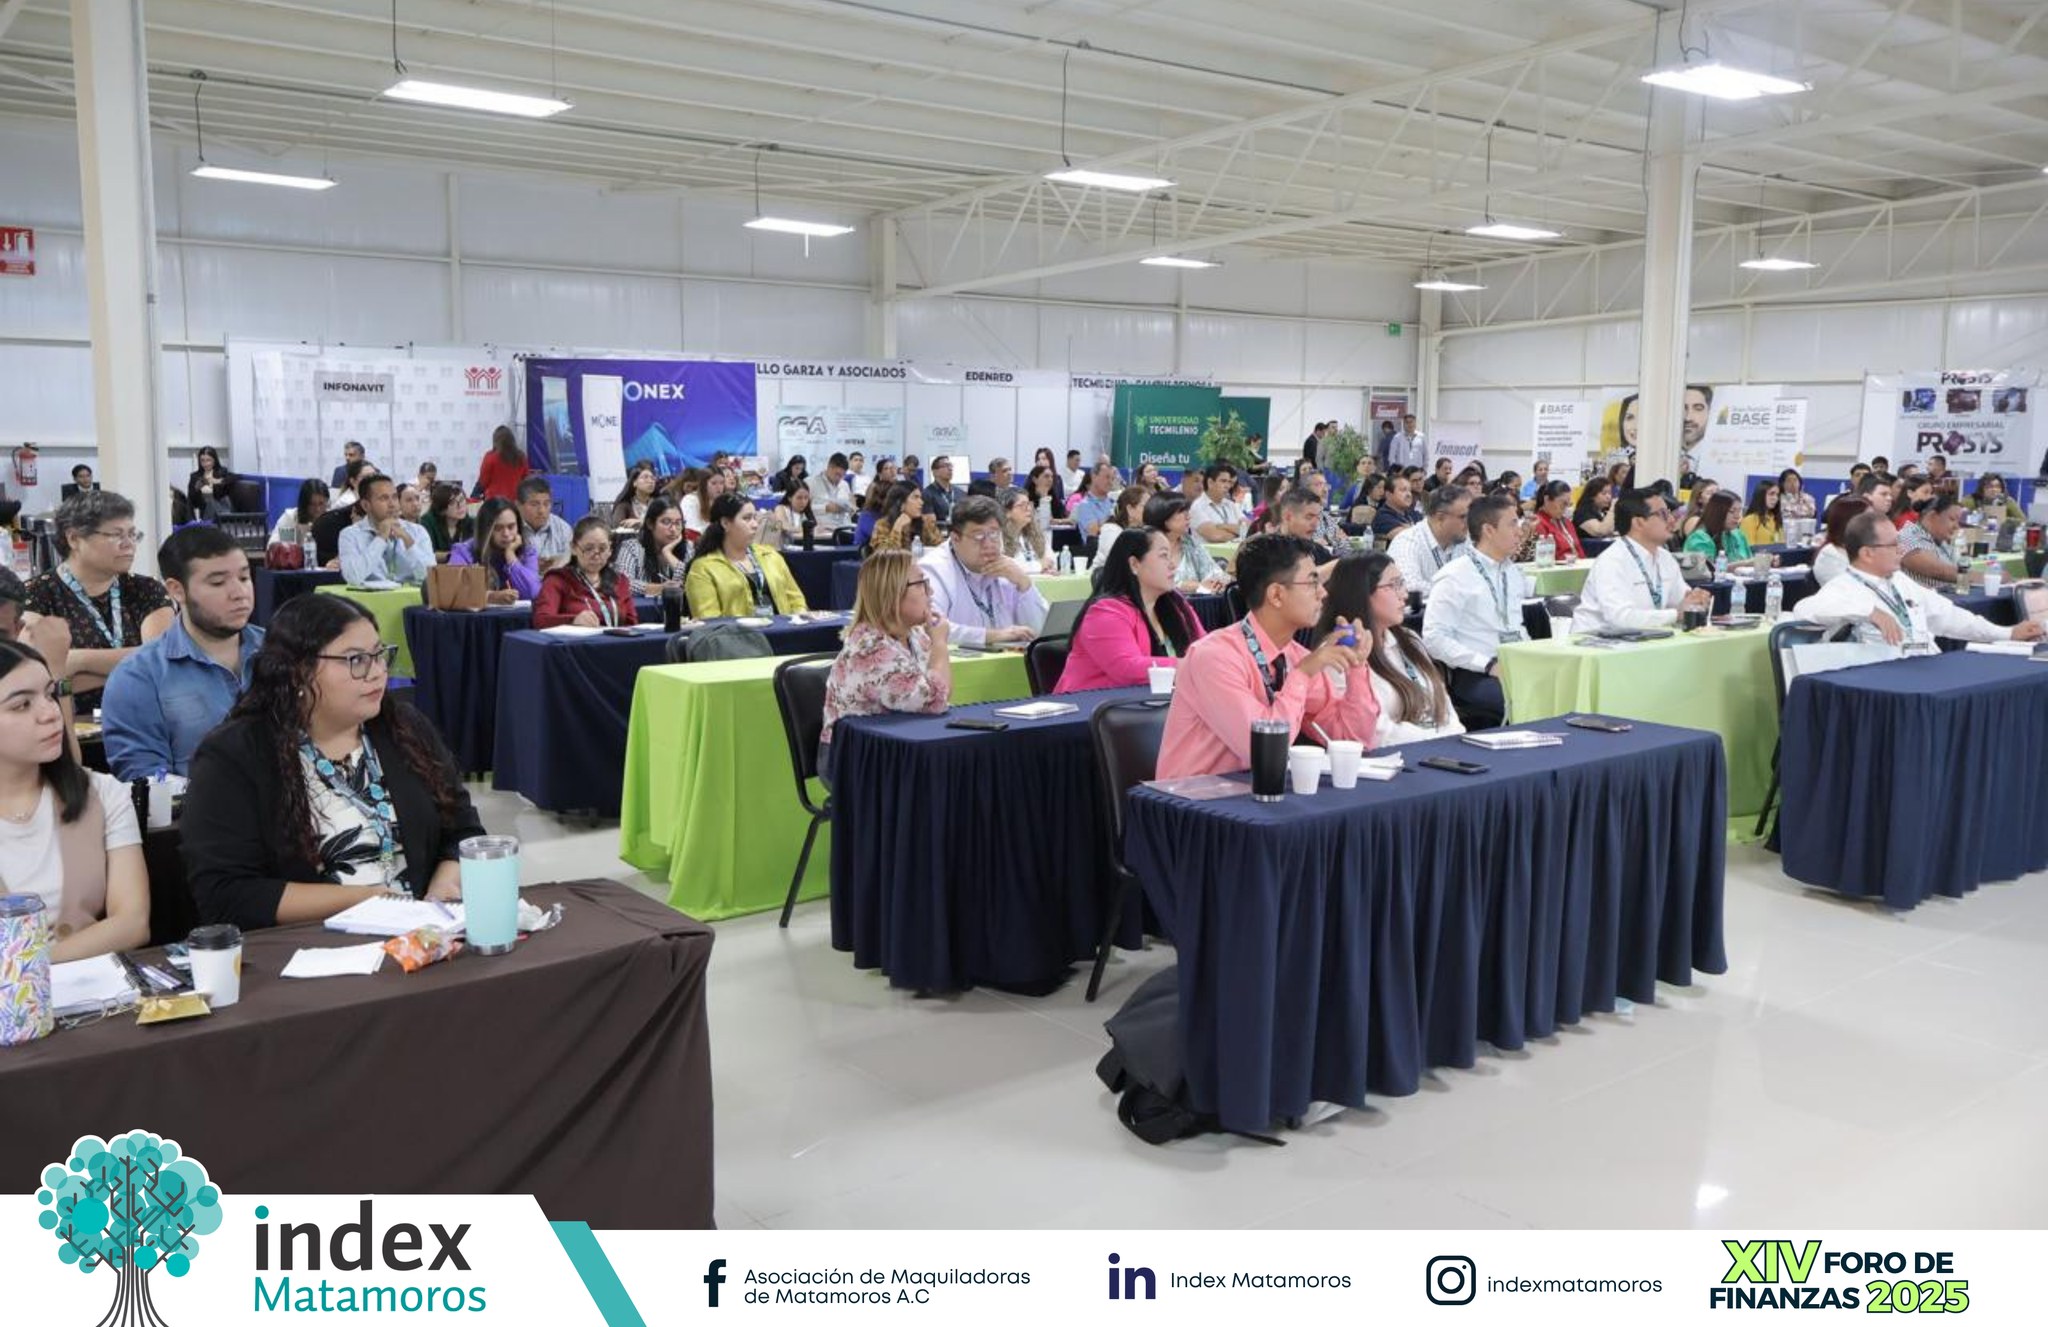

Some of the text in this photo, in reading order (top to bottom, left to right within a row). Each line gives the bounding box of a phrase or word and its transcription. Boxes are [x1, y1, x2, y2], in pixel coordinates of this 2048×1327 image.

[756, 363, 907, 379] LLO GARZA Y ASOCIADOS
[965, 371, 1014, 382] EDENRED
[323, 381, 385, 393] INFONAVIT
[623, 381, 685, 401] ONEX
[1547, 404, 1574, 414] BASE
[591, 414, 618, 428] MONE
[1149, 416, 1200, 425] UNIVERSIDAD
[1730, 413, 1772, 425] BASE
[1149, 425, 1200, 436] TECMILENIO
[1434, 440, 1479, 457] fonacot
[1140, 452, 1190, 464] Diseña tu
